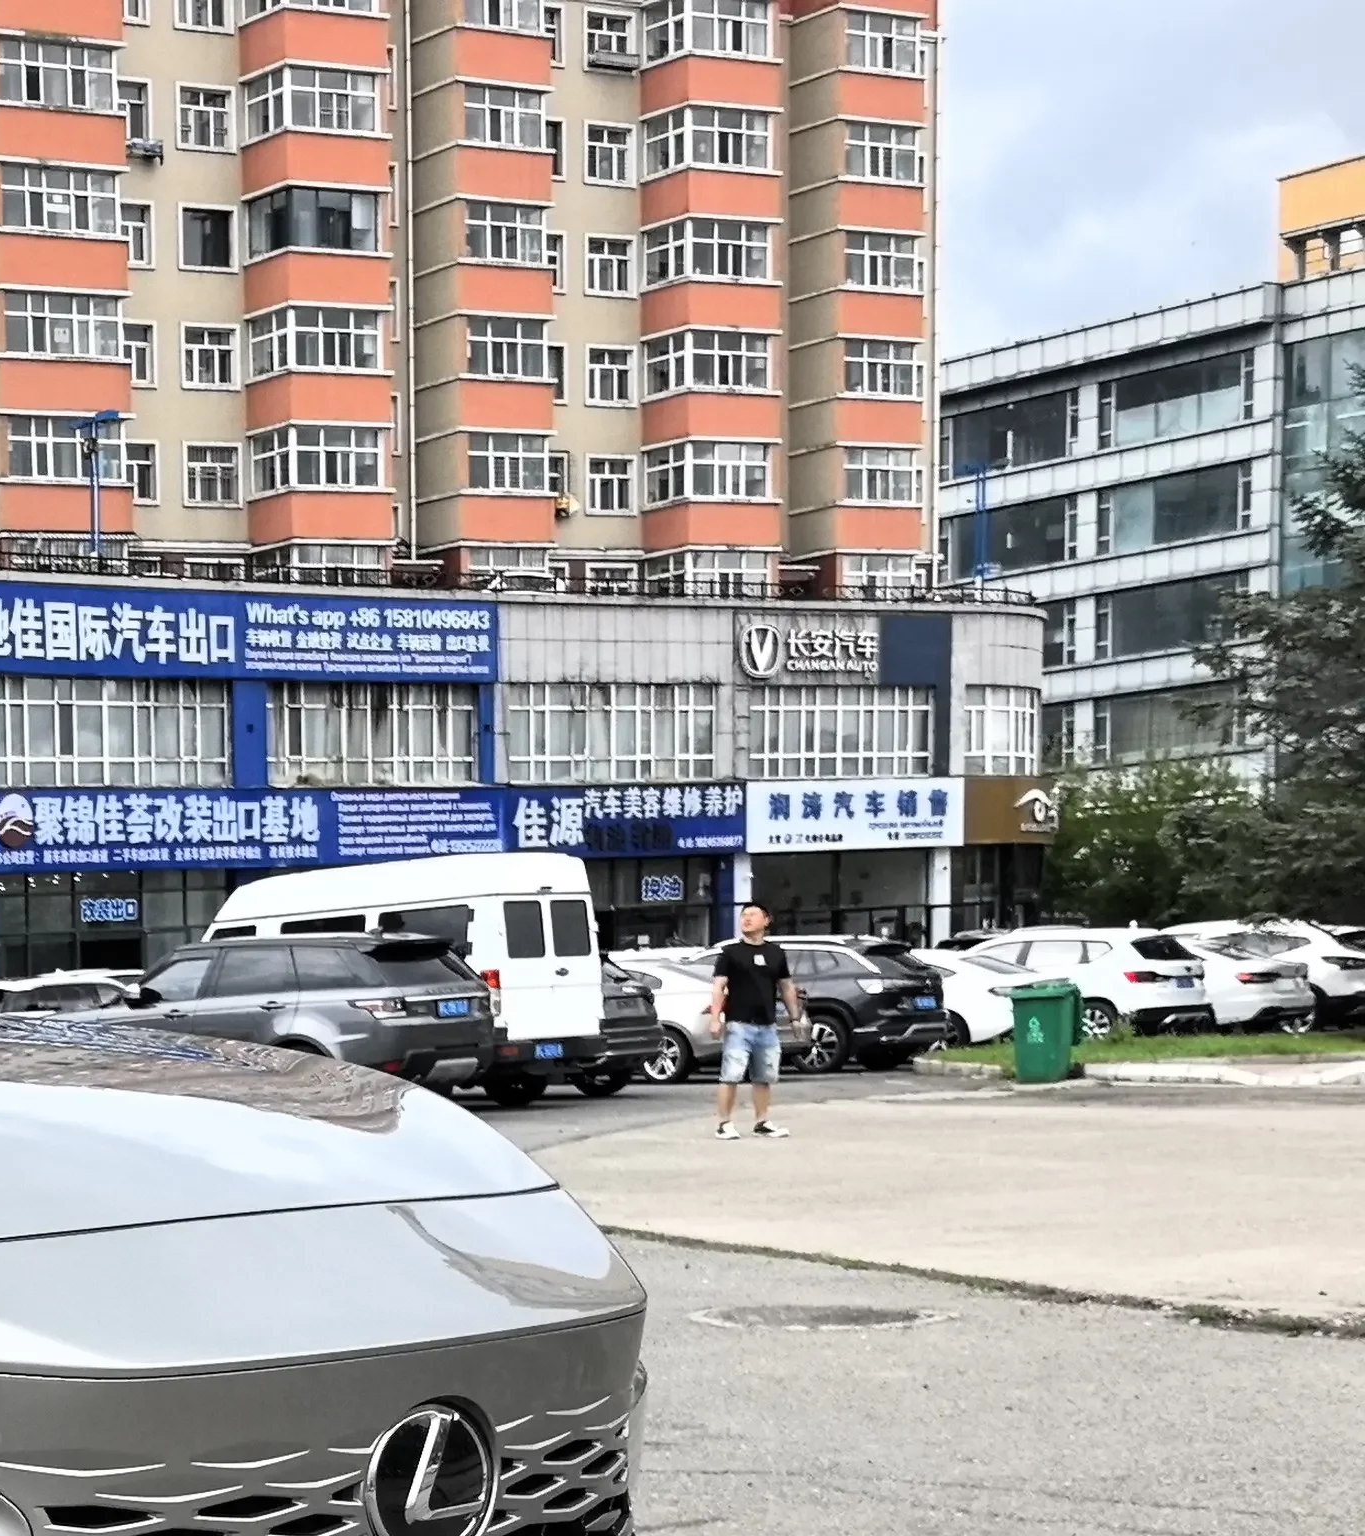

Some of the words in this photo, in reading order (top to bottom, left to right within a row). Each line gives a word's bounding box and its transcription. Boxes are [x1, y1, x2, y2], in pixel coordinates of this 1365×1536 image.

[245, 602, 308, 626] What's
[312, 608, 345, 630] app
[349, 607, 380, 627] +86
[787, 628, 879, 658] 长安汽车
[786, 659, 845, 672] CHANGAN
[846, 660, 879, 672] AUTO
[512, 796, 584, 848] 佳源
